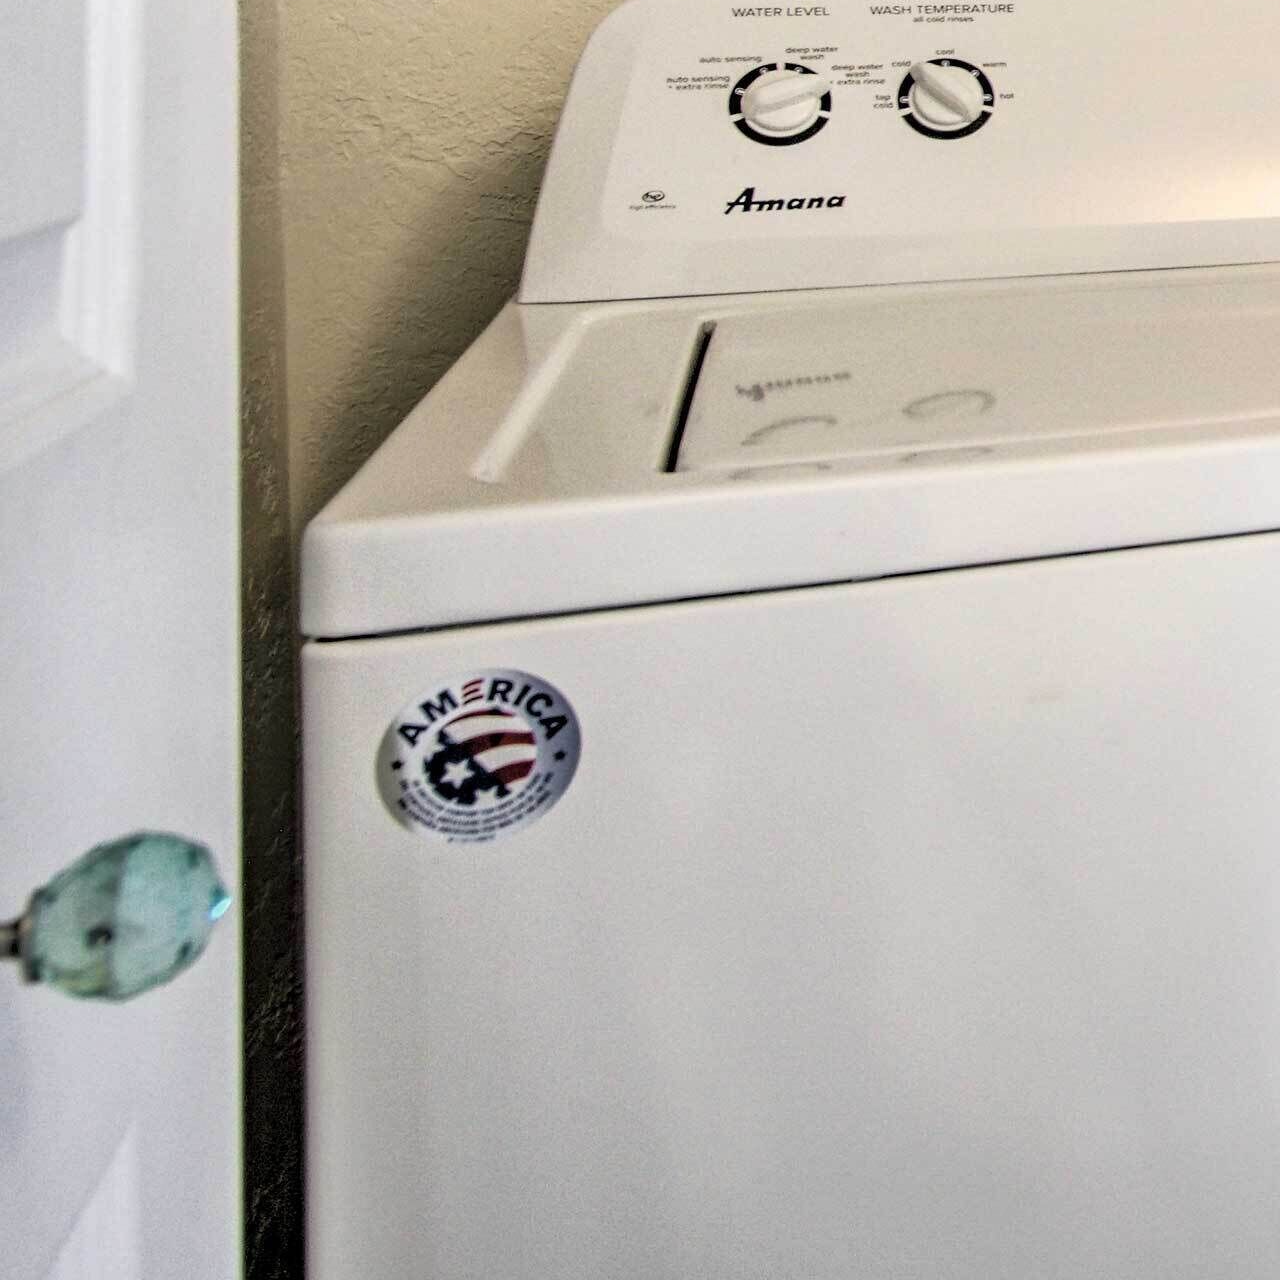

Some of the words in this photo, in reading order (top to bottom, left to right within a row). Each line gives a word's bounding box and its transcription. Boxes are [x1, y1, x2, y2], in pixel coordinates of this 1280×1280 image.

[732, 7, 782, 17] WATER
[787, 6, 830, 17] LEVEL
[869, 5, 912, 15] WASH
[917, 3, 1015, 14] TEMPERATURE
[801, 53, 825, 61] wash
[724, 187, 846, 215] Amana
[398, 678, 569, 746] AMERICA
